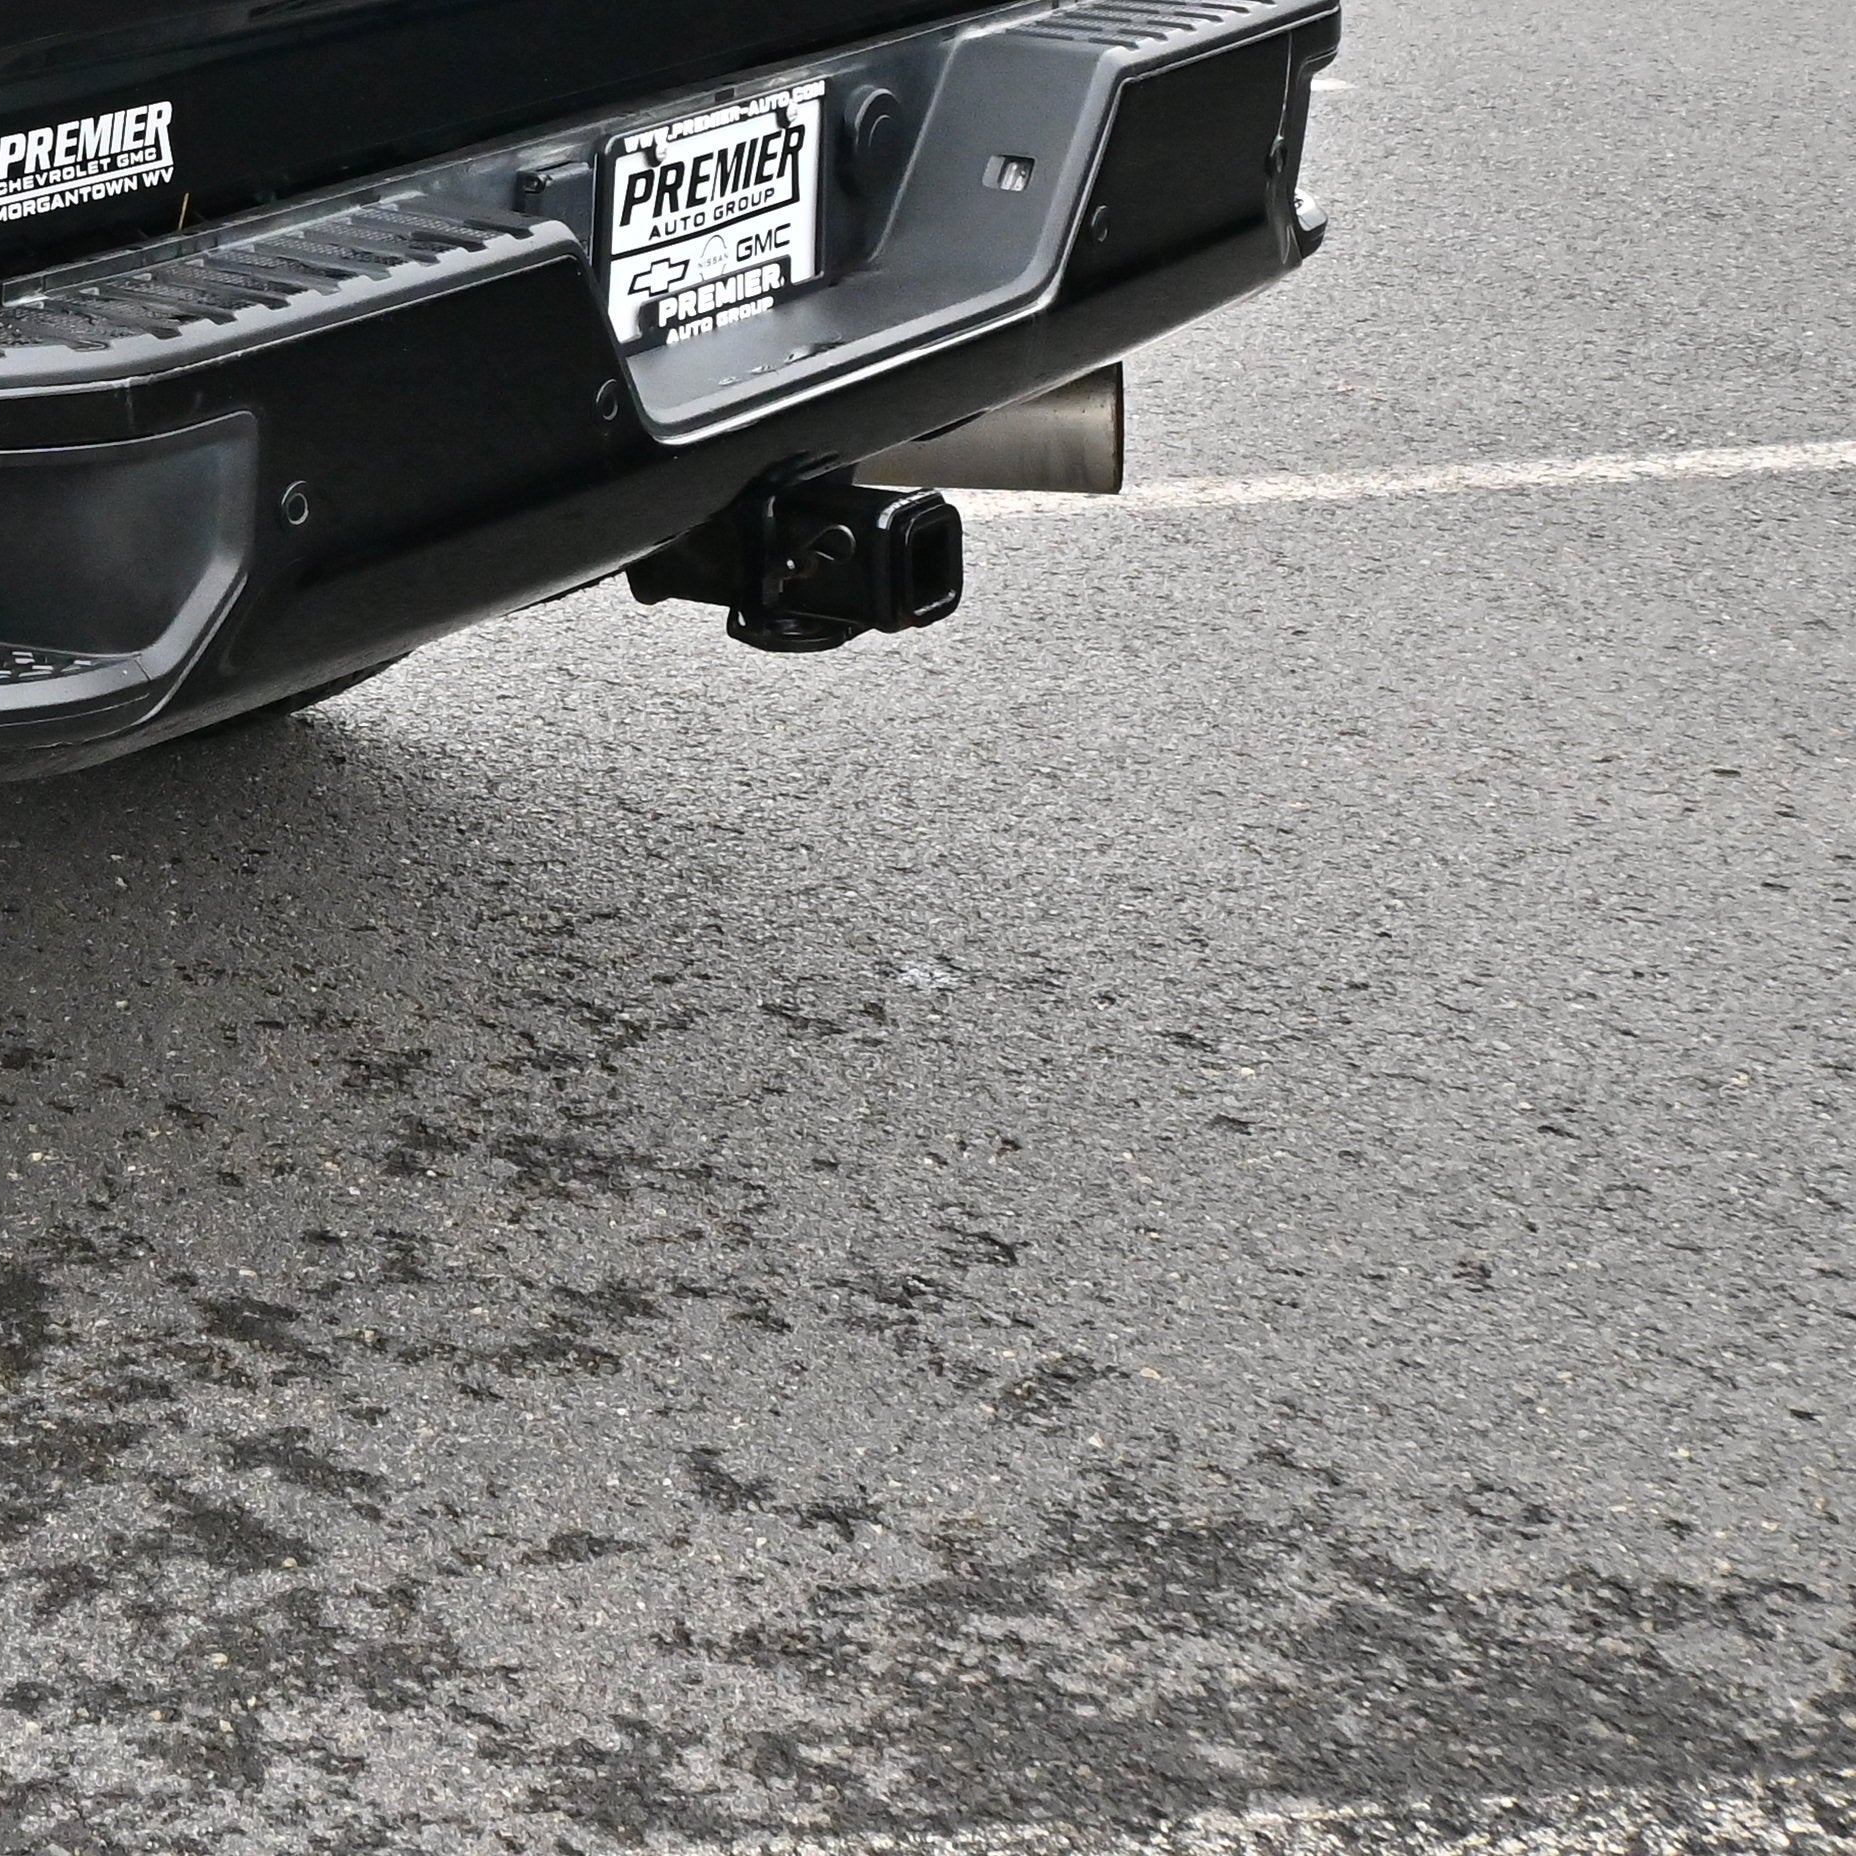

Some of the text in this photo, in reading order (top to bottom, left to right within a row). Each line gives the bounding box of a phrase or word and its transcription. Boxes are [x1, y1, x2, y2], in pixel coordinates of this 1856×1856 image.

[116, 146, 158, 168] GMC
[619, 124, 806, 228] PREMIER
[142, 167, 175, 189] WV
[648, 187, 775, 241] AUTO GROUP
[697, 252, 730, 269] NISSAN
[736, 223, 791, 263] GMC
[666, 295, 775, 345] AUTO GROUP
